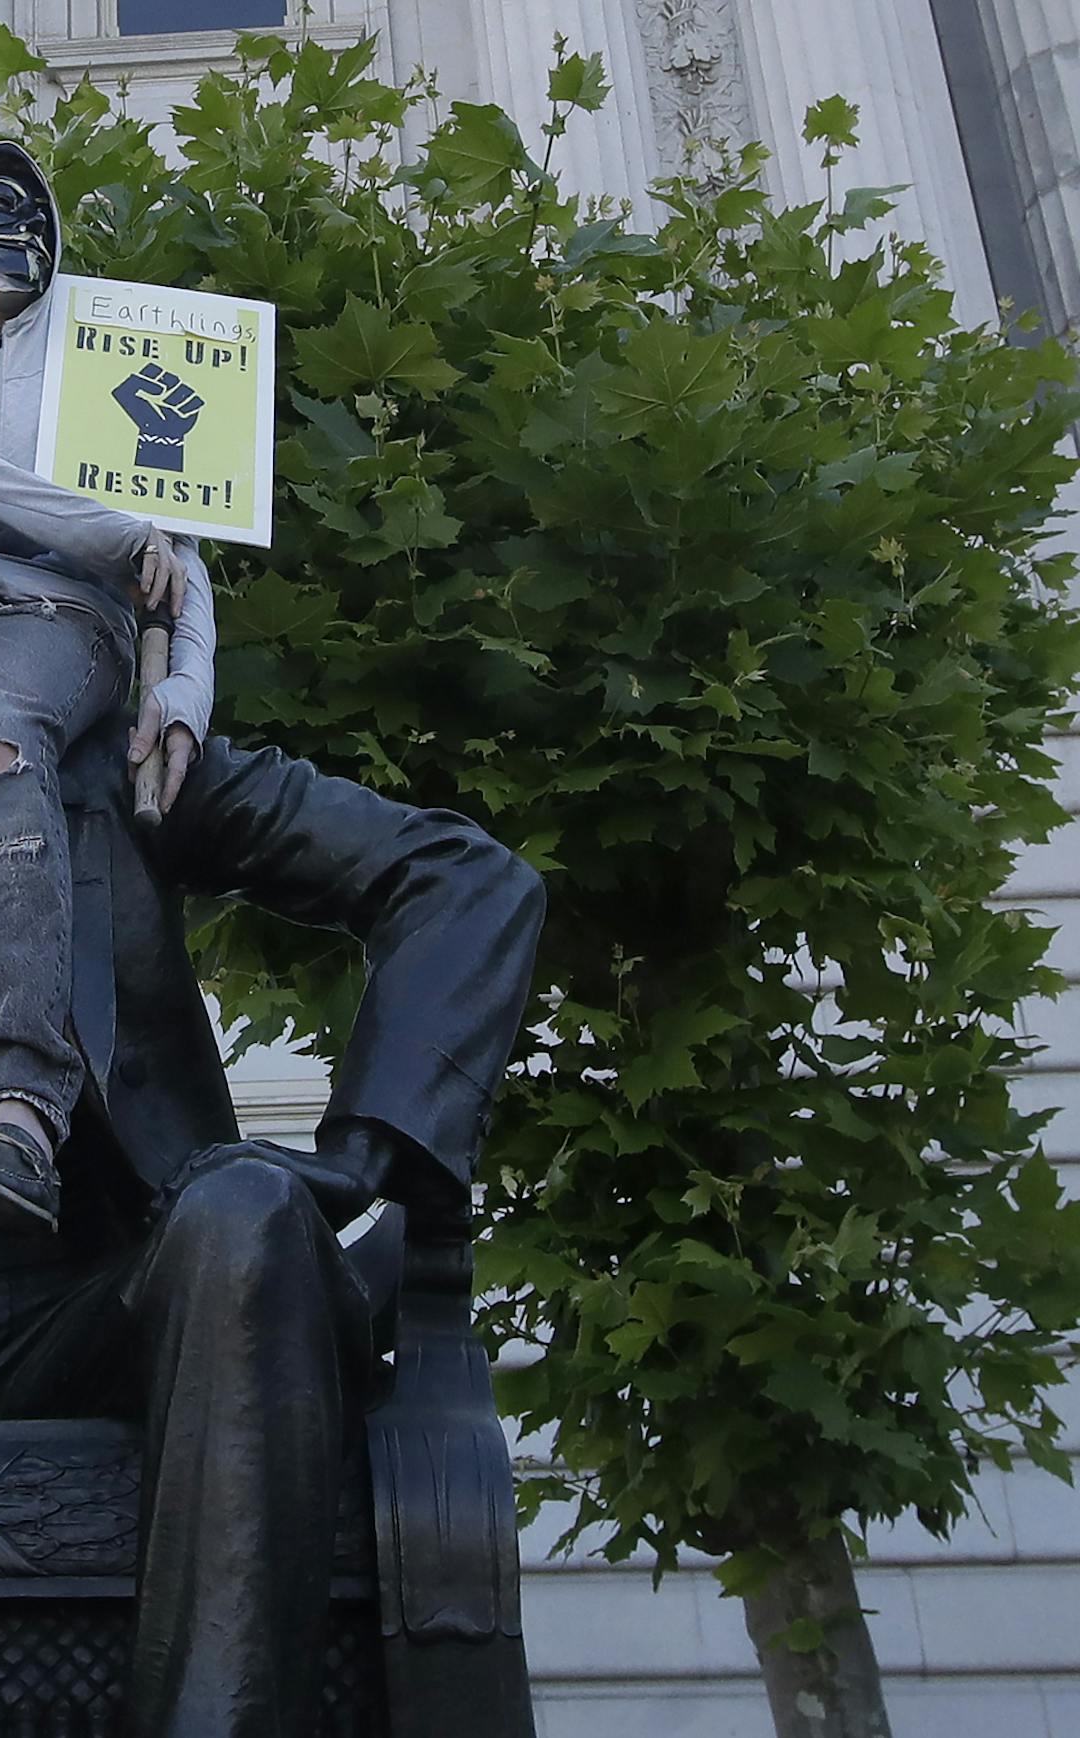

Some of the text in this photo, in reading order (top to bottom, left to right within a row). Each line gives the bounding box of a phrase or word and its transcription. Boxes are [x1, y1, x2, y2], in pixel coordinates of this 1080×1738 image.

[76, 326, 248, 372] RISE UP!
[78, 462, 233, 509] RESIST!
